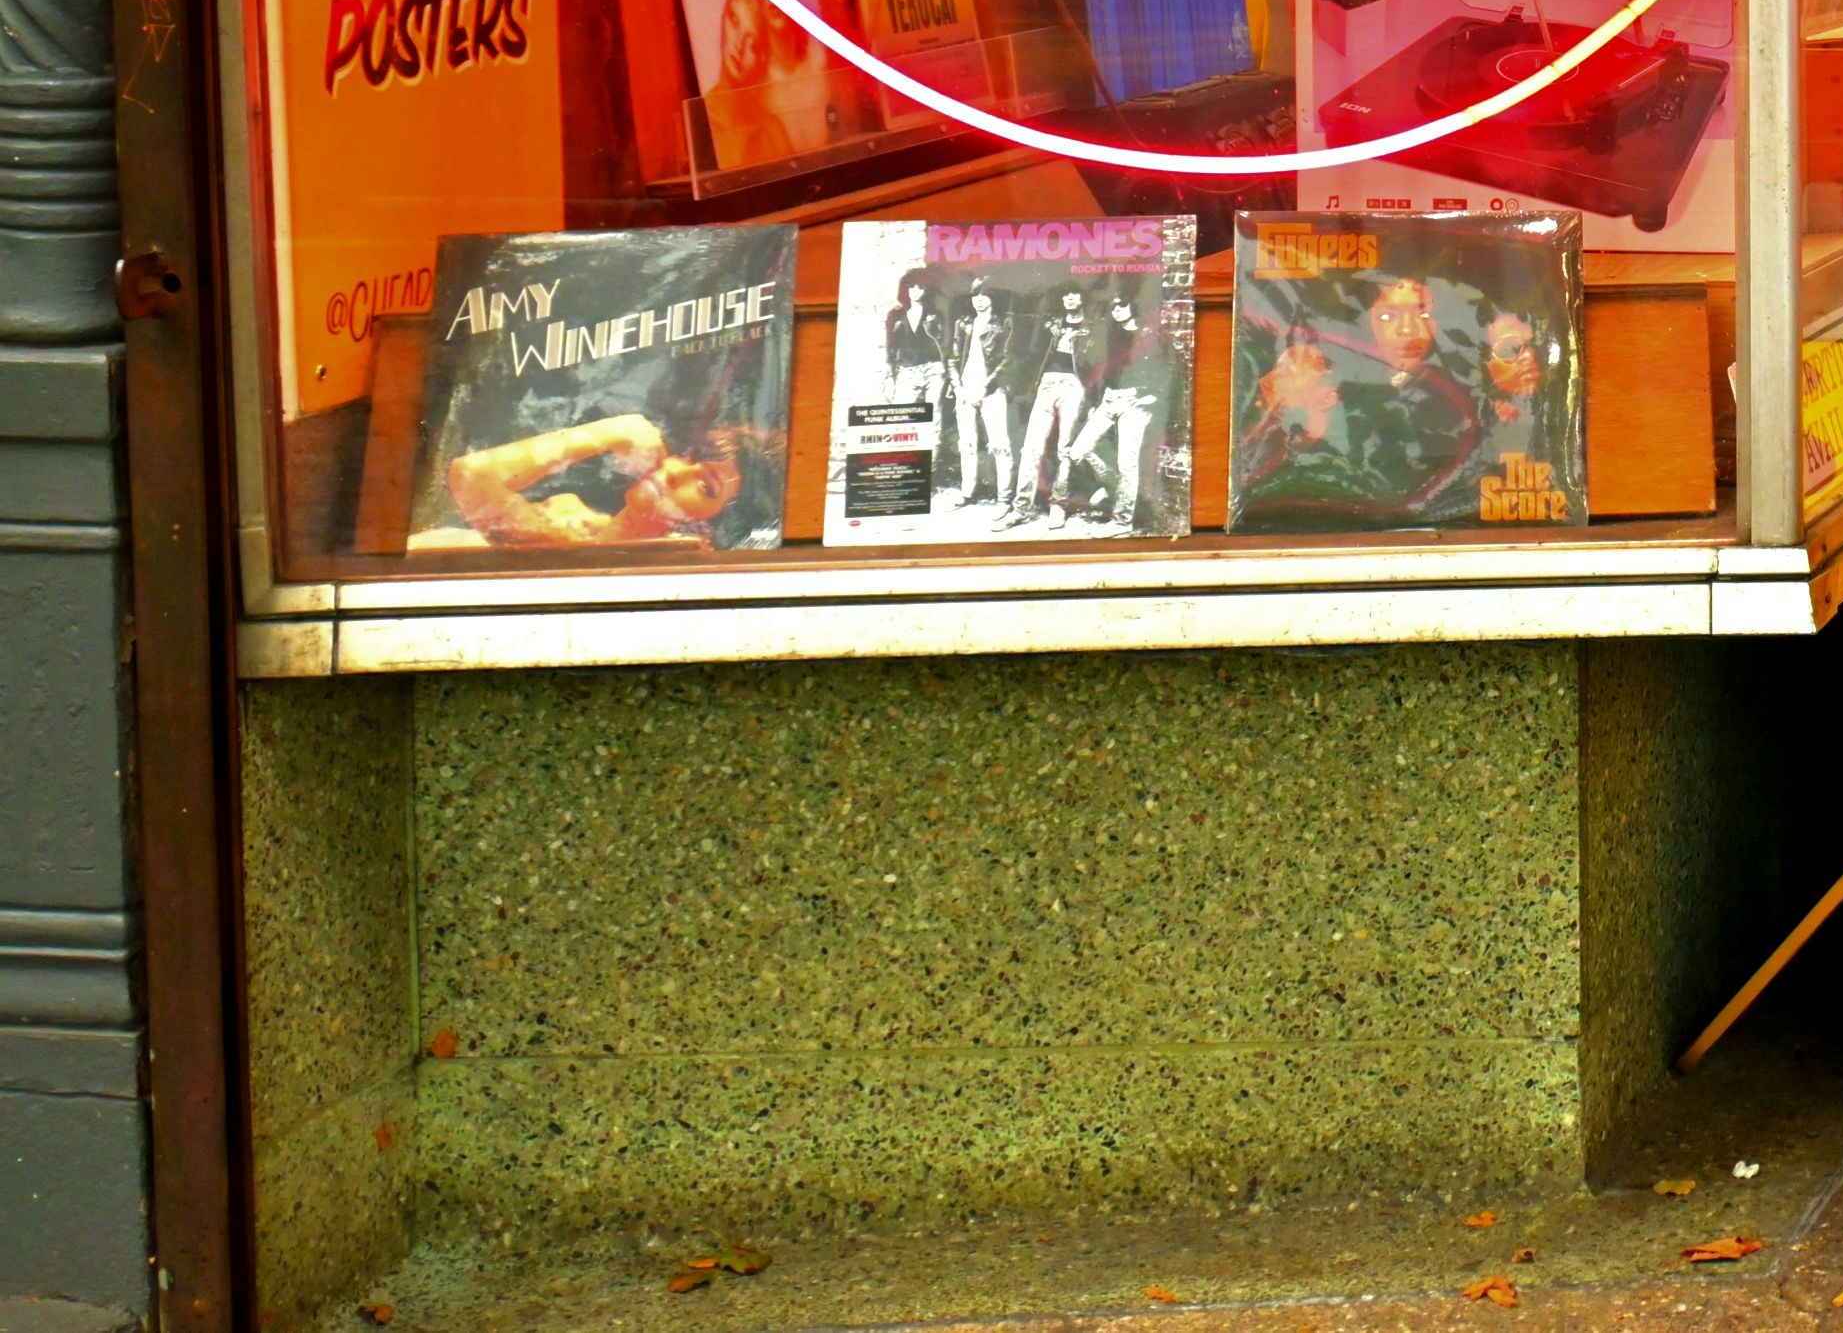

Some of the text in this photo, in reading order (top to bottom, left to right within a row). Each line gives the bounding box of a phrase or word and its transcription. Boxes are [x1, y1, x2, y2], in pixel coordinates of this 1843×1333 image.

[1337, 102, 1372, 115] ION
[926, 220, 1164, 264] RAMONES
[1254, 222, 1380, 280] Fugees
[446, 278, 562, 342] AMY
[510, 280, 777, 377] WINEHOUSE
[1502, 452, 1554, 490] The
[1480, 476, 1568, 521] Score
